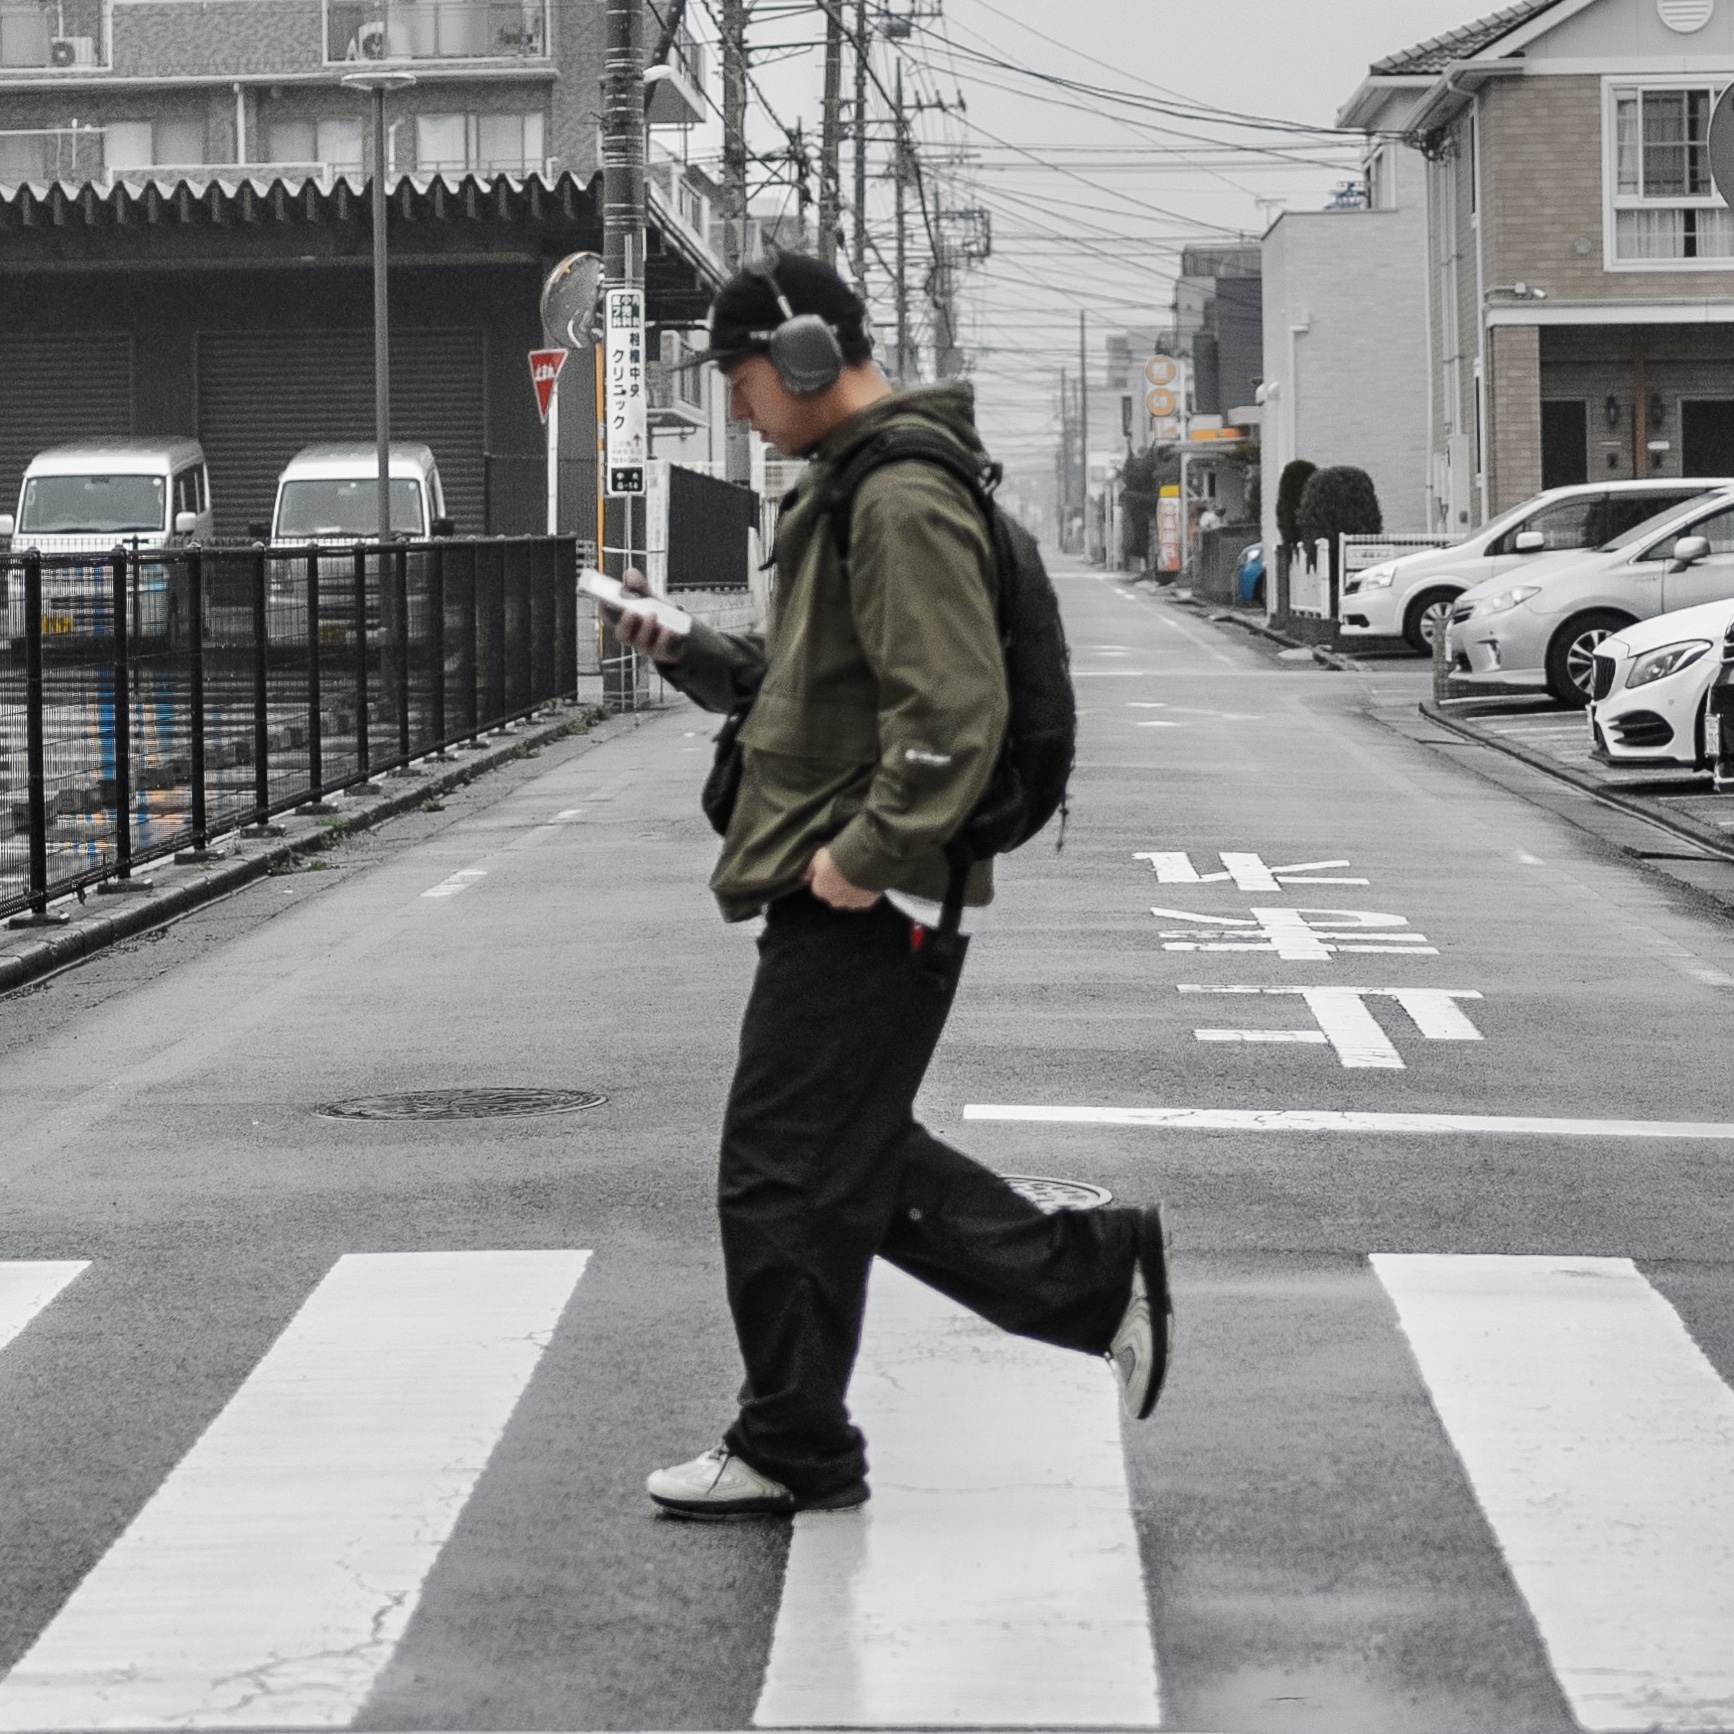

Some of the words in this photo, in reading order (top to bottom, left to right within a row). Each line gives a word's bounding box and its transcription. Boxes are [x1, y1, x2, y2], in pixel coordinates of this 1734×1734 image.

[612, 349, 627, 430] クリニック
[1132, 851, 1484, 1069] 止まれ
